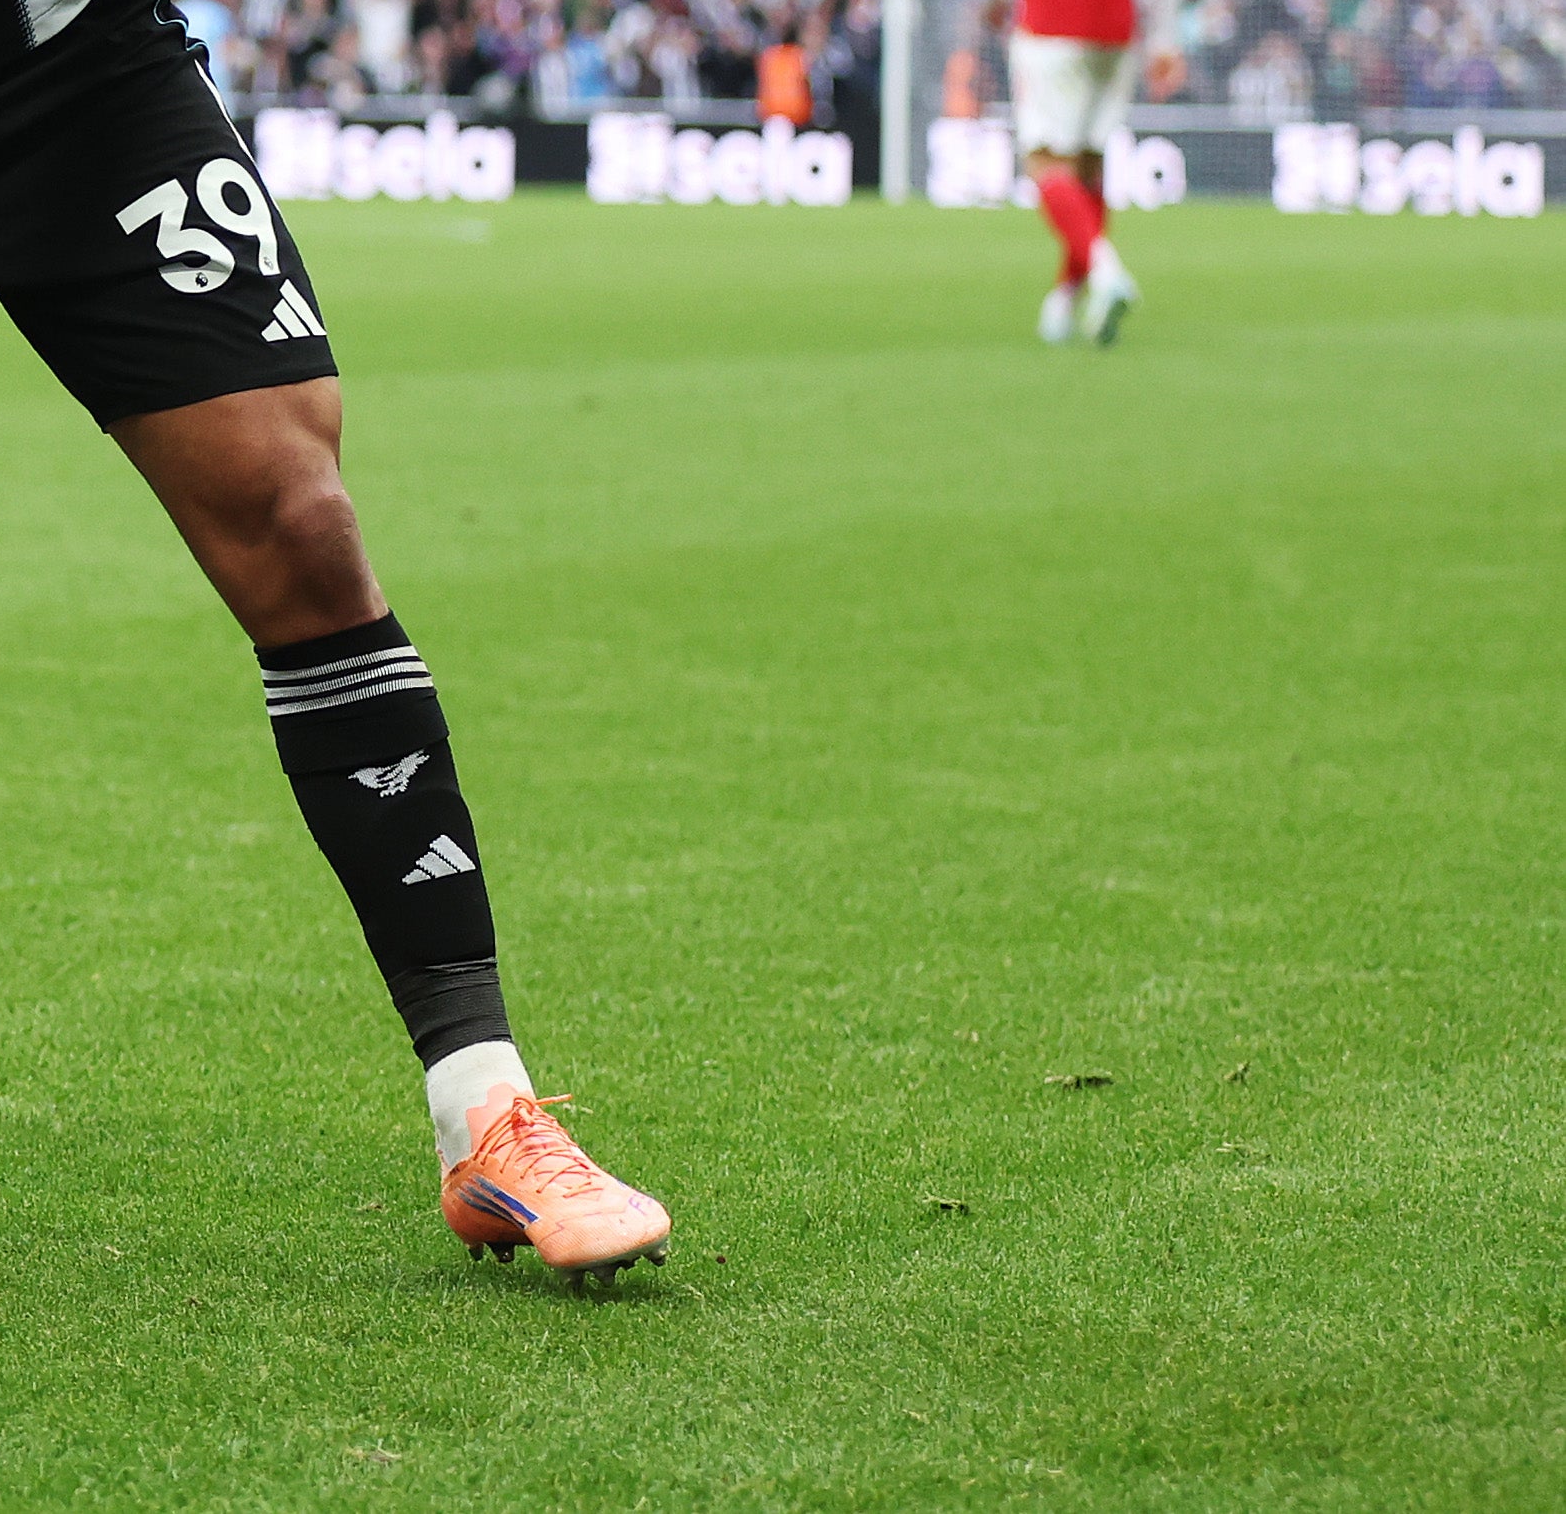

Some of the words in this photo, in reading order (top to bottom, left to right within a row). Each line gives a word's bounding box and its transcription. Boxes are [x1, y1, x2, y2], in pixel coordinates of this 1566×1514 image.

[336, 110, 516, 203] sela
[670, 115, 851, 206] sela
[1361, 126, 1544, 218] sela
[115, 157, 280, 294] 39
